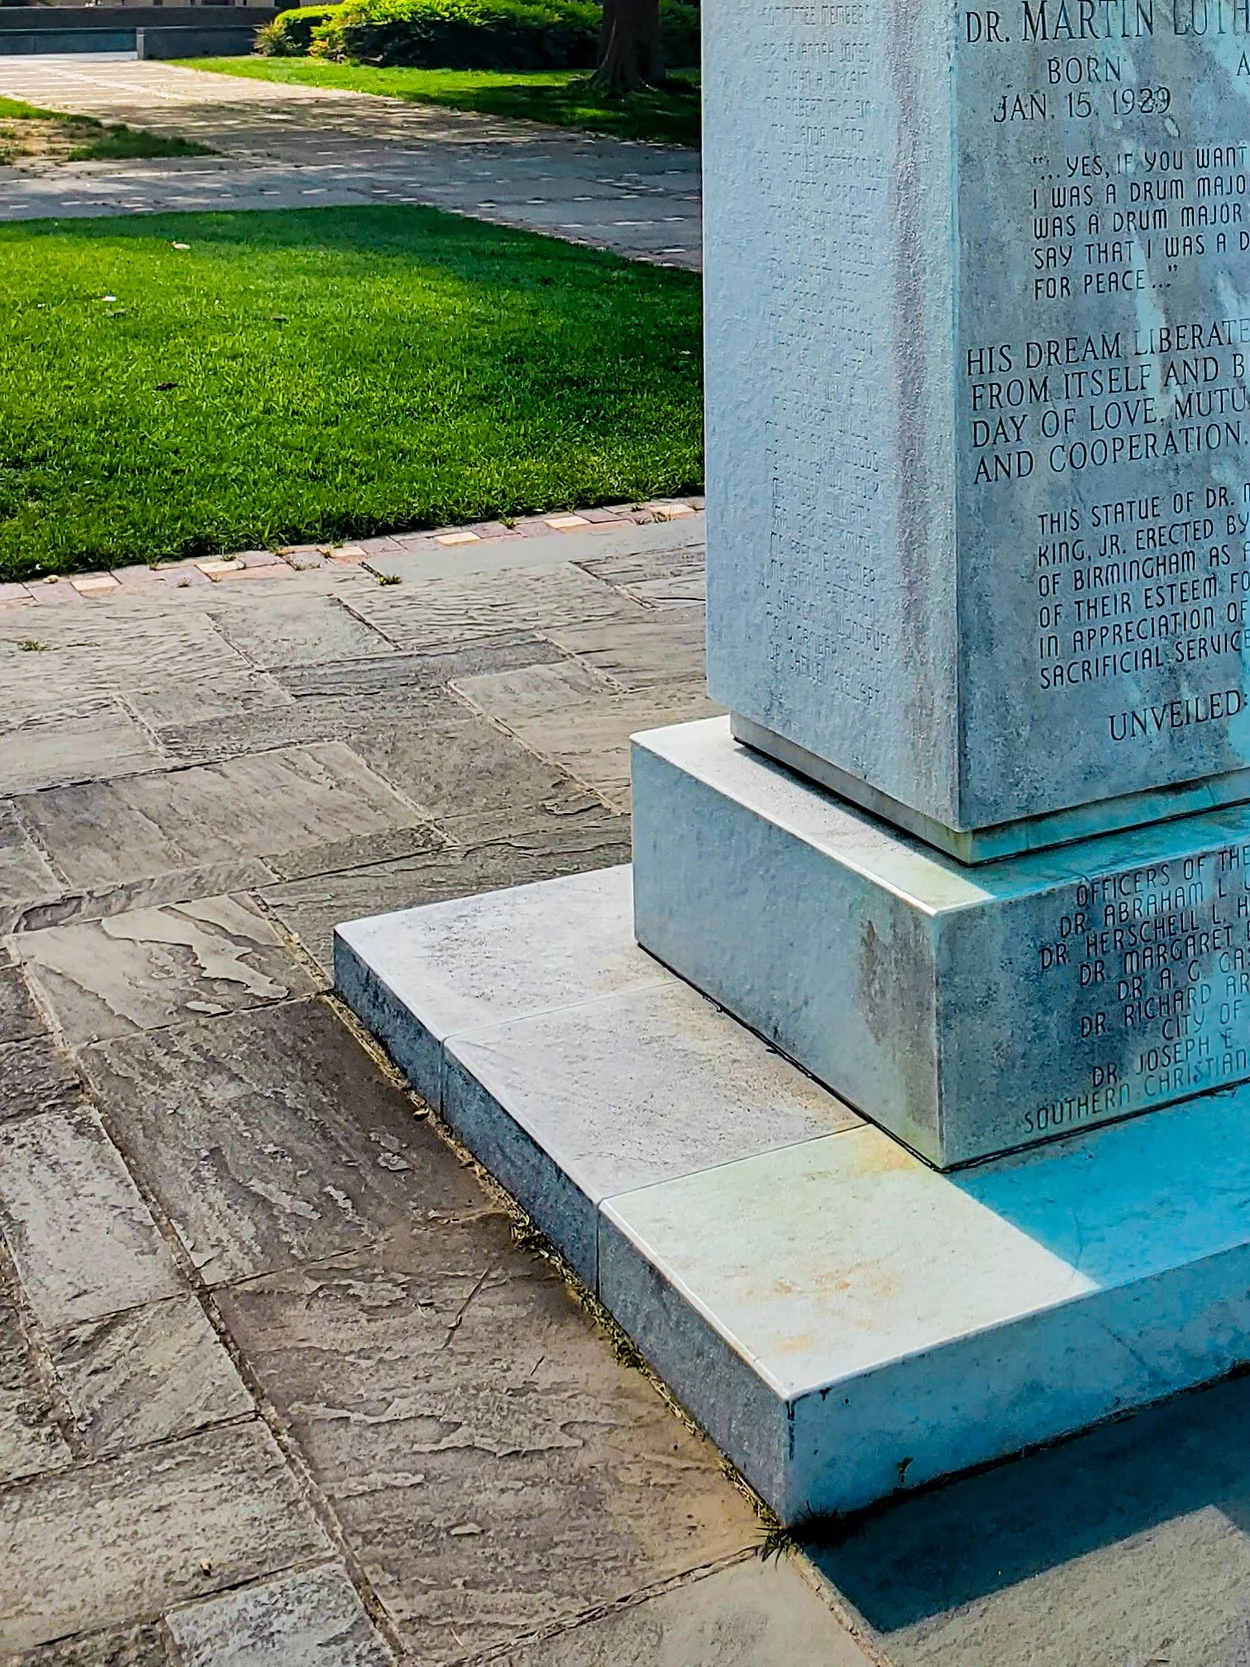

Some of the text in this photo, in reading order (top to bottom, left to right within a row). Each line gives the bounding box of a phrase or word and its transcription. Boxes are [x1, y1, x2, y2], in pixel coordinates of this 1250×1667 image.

[966, 11, 1010, 43] DR.
[1048, 56, 1122, 84] BORN
[993, 94, 1055, 123] JAN.
[1112, 87, 1171, 116] 1929
[1117, 153, 1133, 175] IF
[1144, 150, 1183, 172] YOU
[1196, 146, 1247, 169] WANT
[1032, 188, 1037, 210] I
[1051, 185, 1094, 209] WAS
[1105, 184, 1117, 205] A
[1130, 179, 1184, 203] DRUM
[1033, 215, 1076, 239] WAS
[1088, 213, 1099, 234] A
[1113, 208, 1167, 233] DRUM
[1181, 202, 1242, 227] MAJOR
[1034, 245, 1073, 270] SAY
[1084, 241, 1134, 264] THAT
[1146, 239, 1151, 259] I
[1165, 234, 1205, 258] WAS
[1216, 232, 1227, 253] A
[1034, 276, 1071, 301] FOR
[967, 344, 1012, 377] HIS
[1025, 332, 1123, 369] DREAM
[972, 375, 1049, 412] FROM
[1063, 363, 1152, 400] ITSELF
[1163, 356, 1219, 388] AND
[972, 414, 1028, 448] DAY
[1041, 408, 1076, 439] OF
[973, 421, 1248, 485] AND COOPERATION.
[1038, 508, 1080, 536] THIS
[1091, 496, 1160, 527] STATUE
[1173, 491, 1194, 514] OF
[1206, 486, 1235, 508] DR.
[1038, 539, 1092, 567] KING,
[1099, 534, 1126, 557] JR.
[1136, 518, 1214, 550] ERECTED
[1226, 511, 1250, 535] BY
[1038, 573, 1061, 597] OF
[1074, 549, 1196, 591] BIRMINGHAM
[1209, 544, 1231, 568] AS
[1039, 604, 1063, 628] OF
[1074, 592, 1132, 622] THEIR
[1144, 576, 1217, 609] ESTEEM
[1040, 634, 1059, 659] IN
[1073, 606, 1214, 654] APPRECIATION
[1227, 599, 1249, 623] OF
[1040, 646, 1164, 690] SACRIFICIAL
[1109, 690, 1248, 741] UNVEILED:
[1076, 864, 1170, 907] OFFICERS
[1183, 854, 1208, 880] OF
[1218, 845, 1250, 872] THE
[1104, 881, 1204, 928] ABRAHAM
[1086, 911, 1199, 958] HERSCHELL
[1212, 904, 1227, 926] L.
[1123, 924, 1233, 975] MARGARET
[1124, 983, 1212, 1026] RICHARD
[1162, 1008, 1205, 1041] CITY
[1220, 999, 1242, 1025] OF
[1136, 1036, 1210, 1075] JOSEPH
[1024, 1083, 1130, 1134] SOUTHERN
[1144, 1048, 1247, 1097] CHRISTIAN
